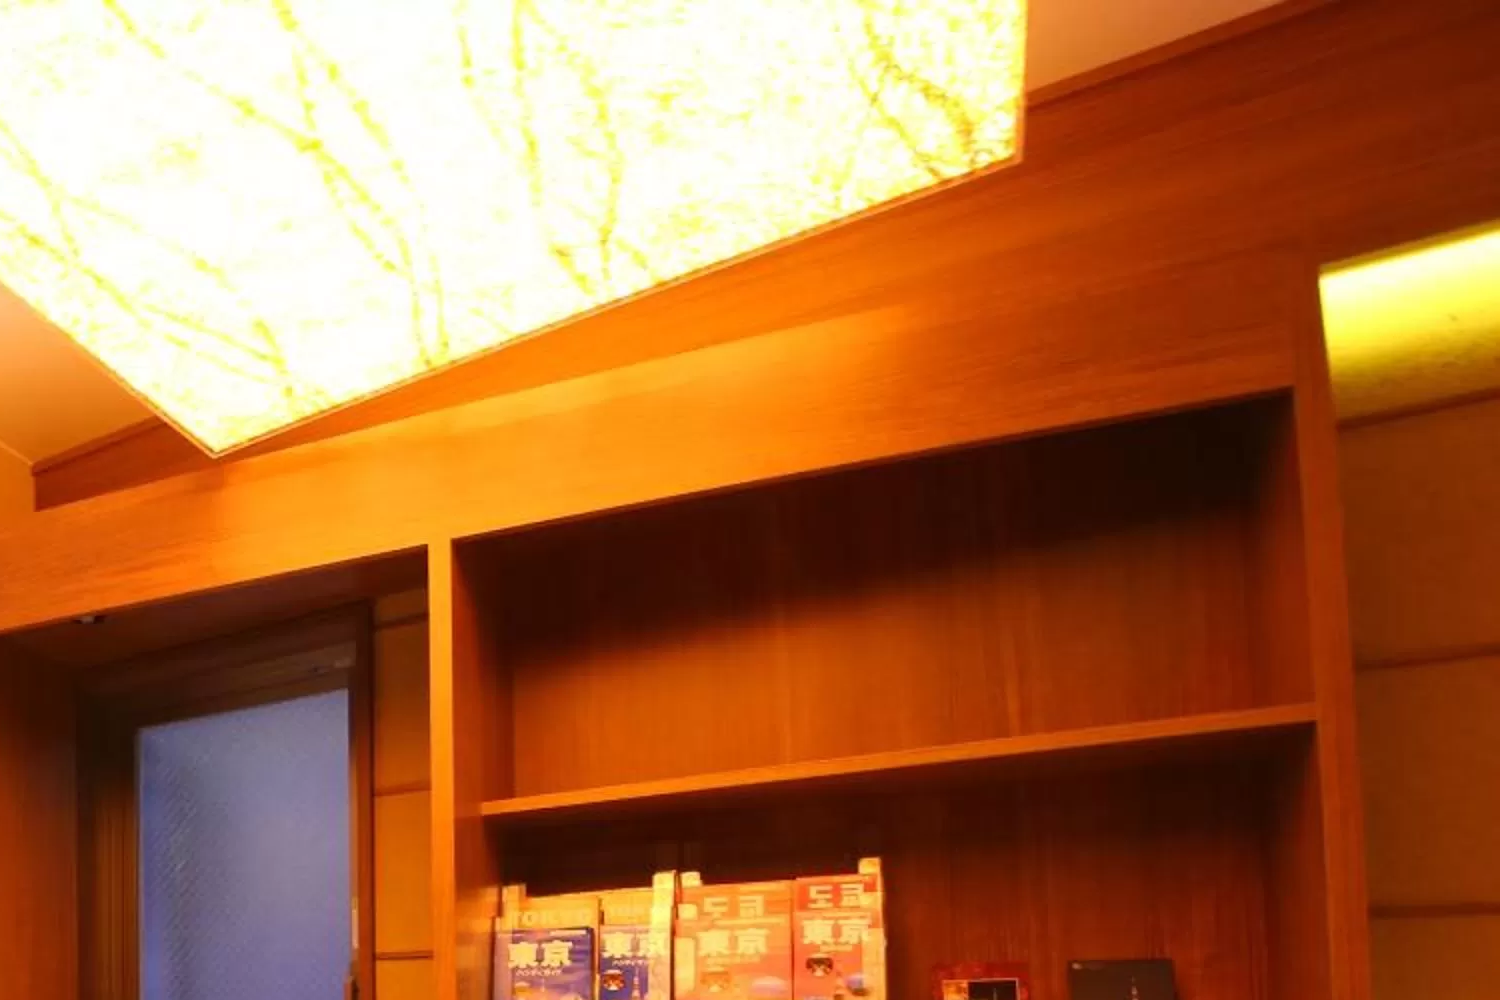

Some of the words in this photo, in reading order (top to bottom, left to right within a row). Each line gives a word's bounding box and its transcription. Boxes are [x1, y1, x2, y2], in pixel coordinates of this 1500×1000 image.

[602, 931, 669, 959] 東京
[697, 928, 770, 957] 東京
[802, 918, 872, 946] 東京
[508, 940, 573, 969] 東京
